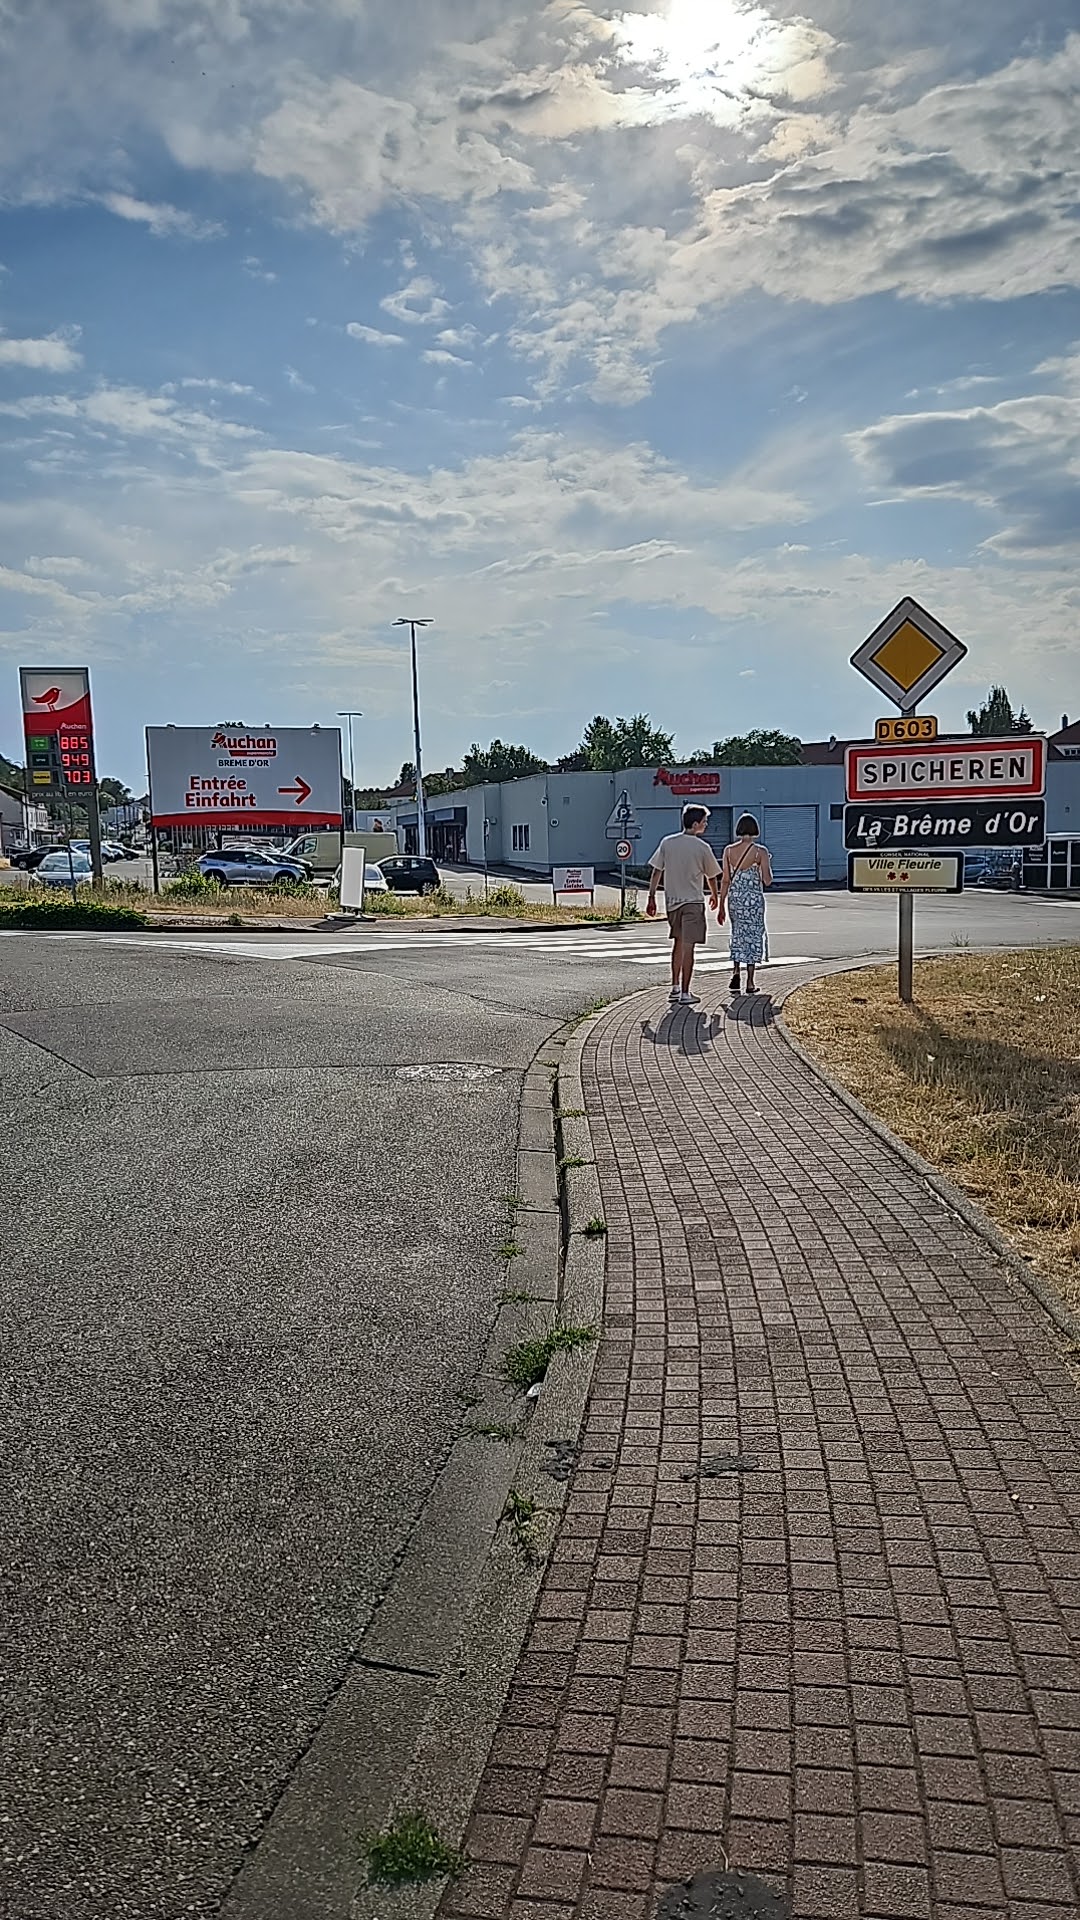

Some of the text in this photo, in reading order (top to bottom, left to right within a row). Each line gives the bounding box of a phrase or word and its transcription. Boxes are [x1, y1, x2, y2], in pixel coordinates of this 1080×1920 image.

[60, 722, 87, 730] Auchan
[878, 719, 933, 739] D603
[61, 736, 88, 750] 885
[211, 732, 277, 749] Auchan
[61, 753, 89, 767] 949
[249, 759, 270, 767] D'OR
[653, 768, 720, 787] Auchan
[863, 756, 1026, 784] SPICHEREN
[190, 775, 247, 790] Entrée
[185, 792, 257, 807] Einfahrt
[857, 811, 1039, 837] La Brême d'Or
[618, 845, 628, 853] 20
[868, 859, 942, 870] Ville Fleurie
